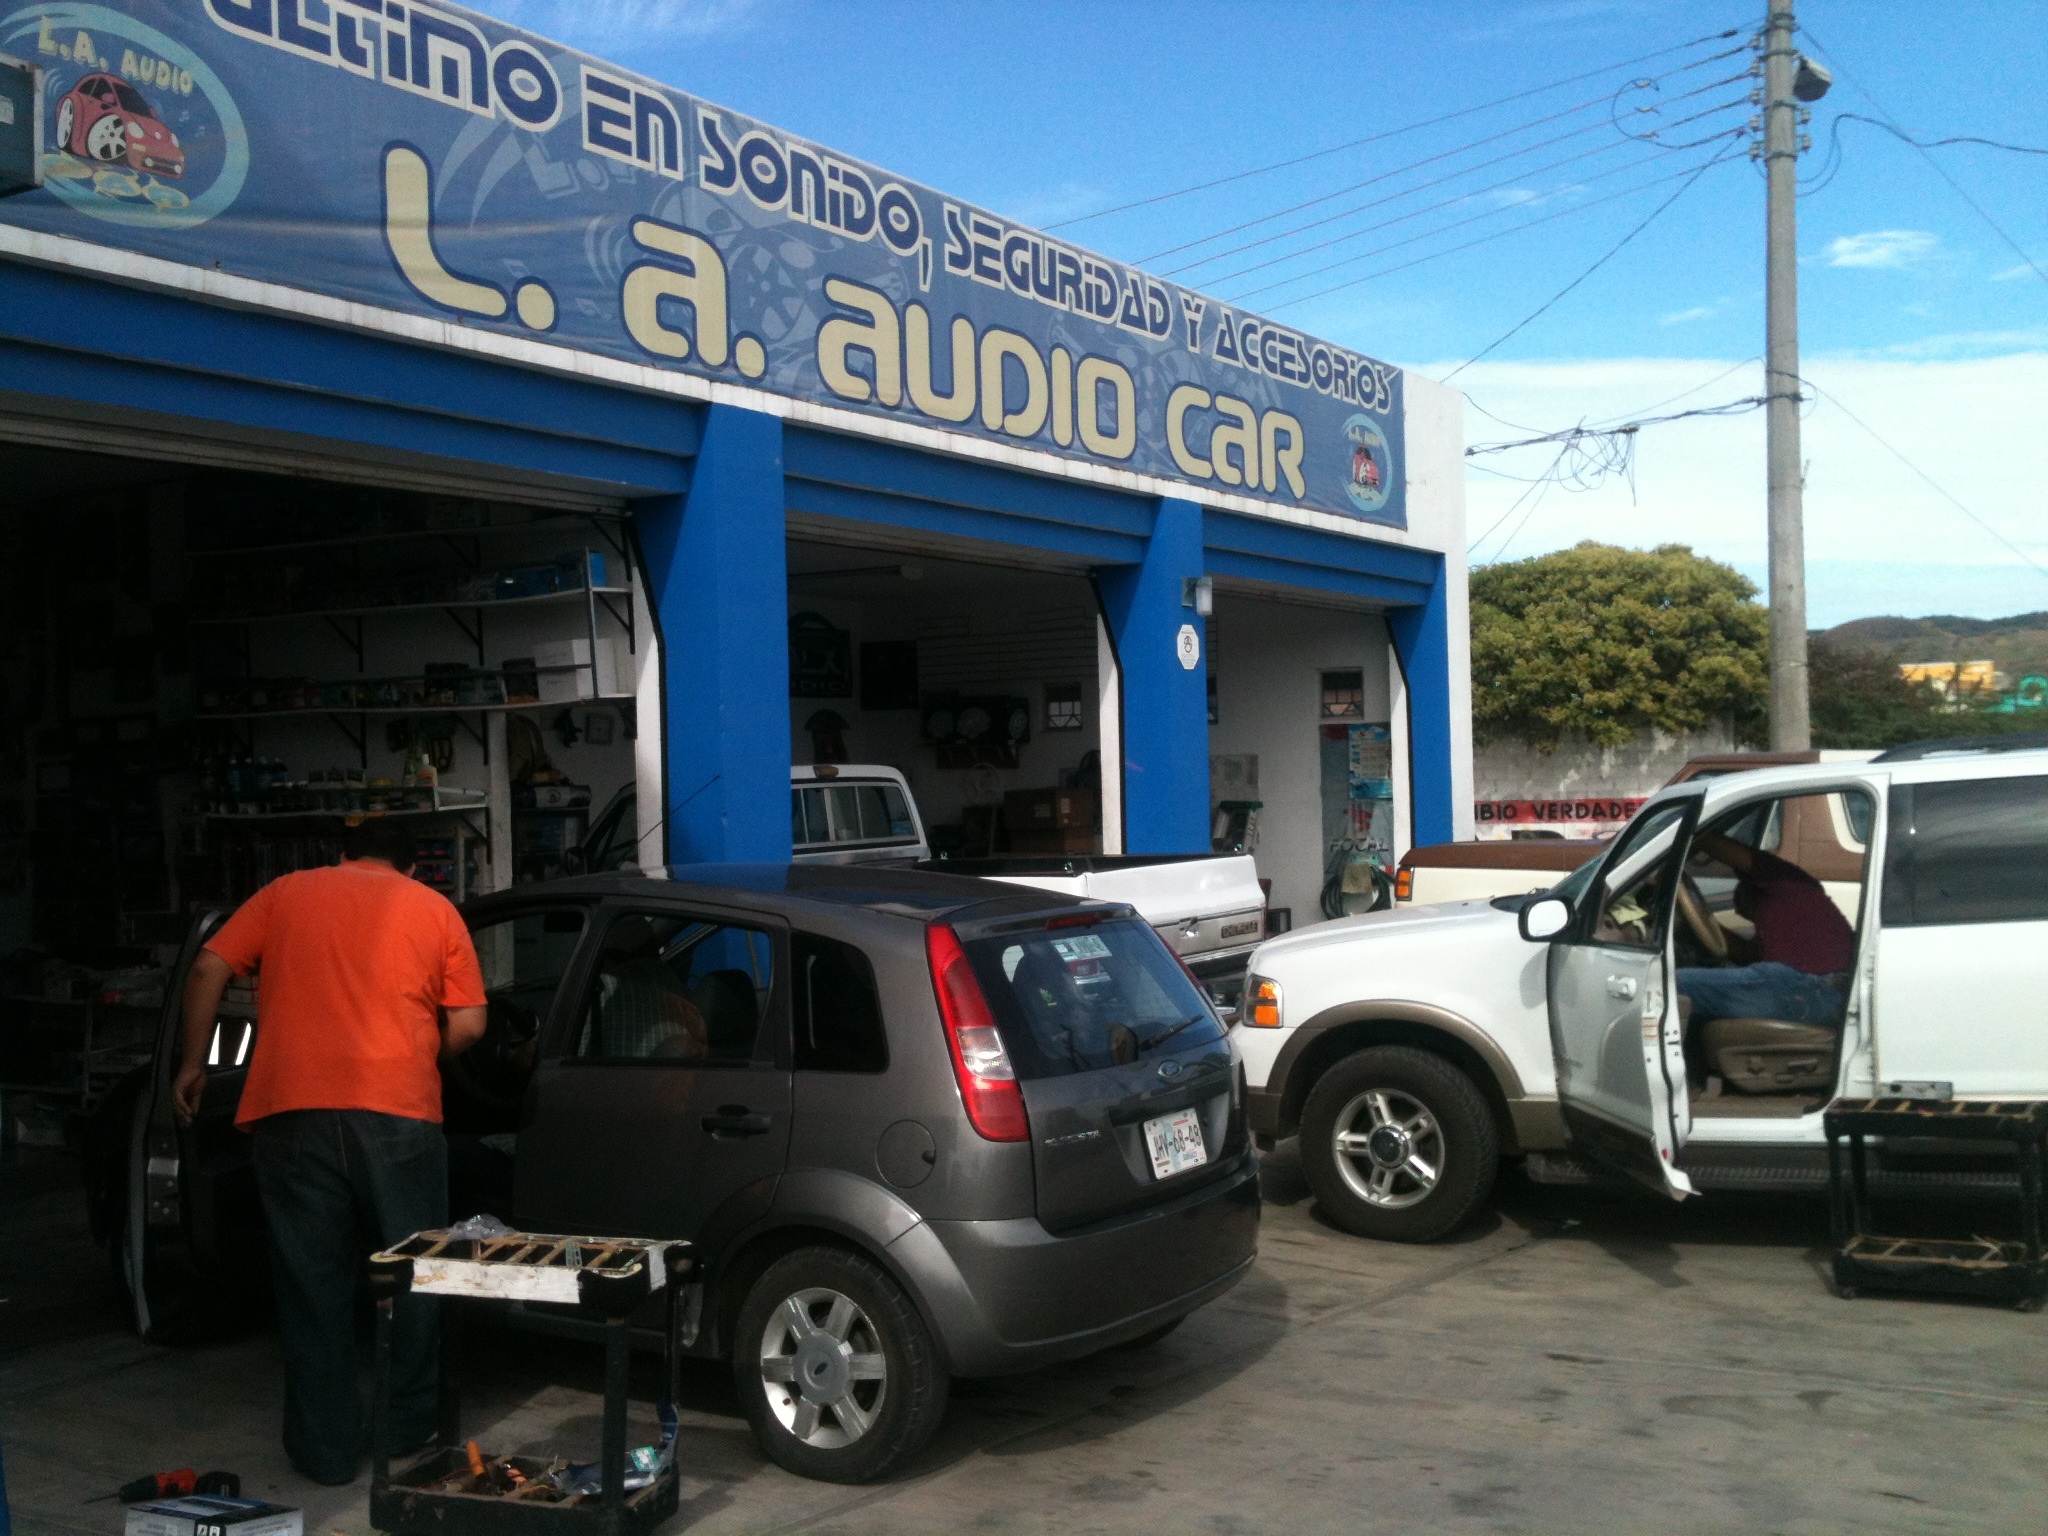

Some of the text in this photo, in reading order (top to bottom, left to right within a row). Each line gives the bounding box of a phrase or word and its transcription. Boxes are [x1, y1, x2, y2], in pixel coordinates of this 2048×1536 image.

[120, 49, 194, 96] AUDIO
[580, 64, 684, 181] EN
[944, 202, 1173, 342] SEGURIDAD
[1178, 292, 1206, 353] Y
[1213, 309, 1392, 416] ACCESORIOS
[1533, 802, 1643, 820] VERDADE
[1330, 837, 1389, 853] FOCAL
